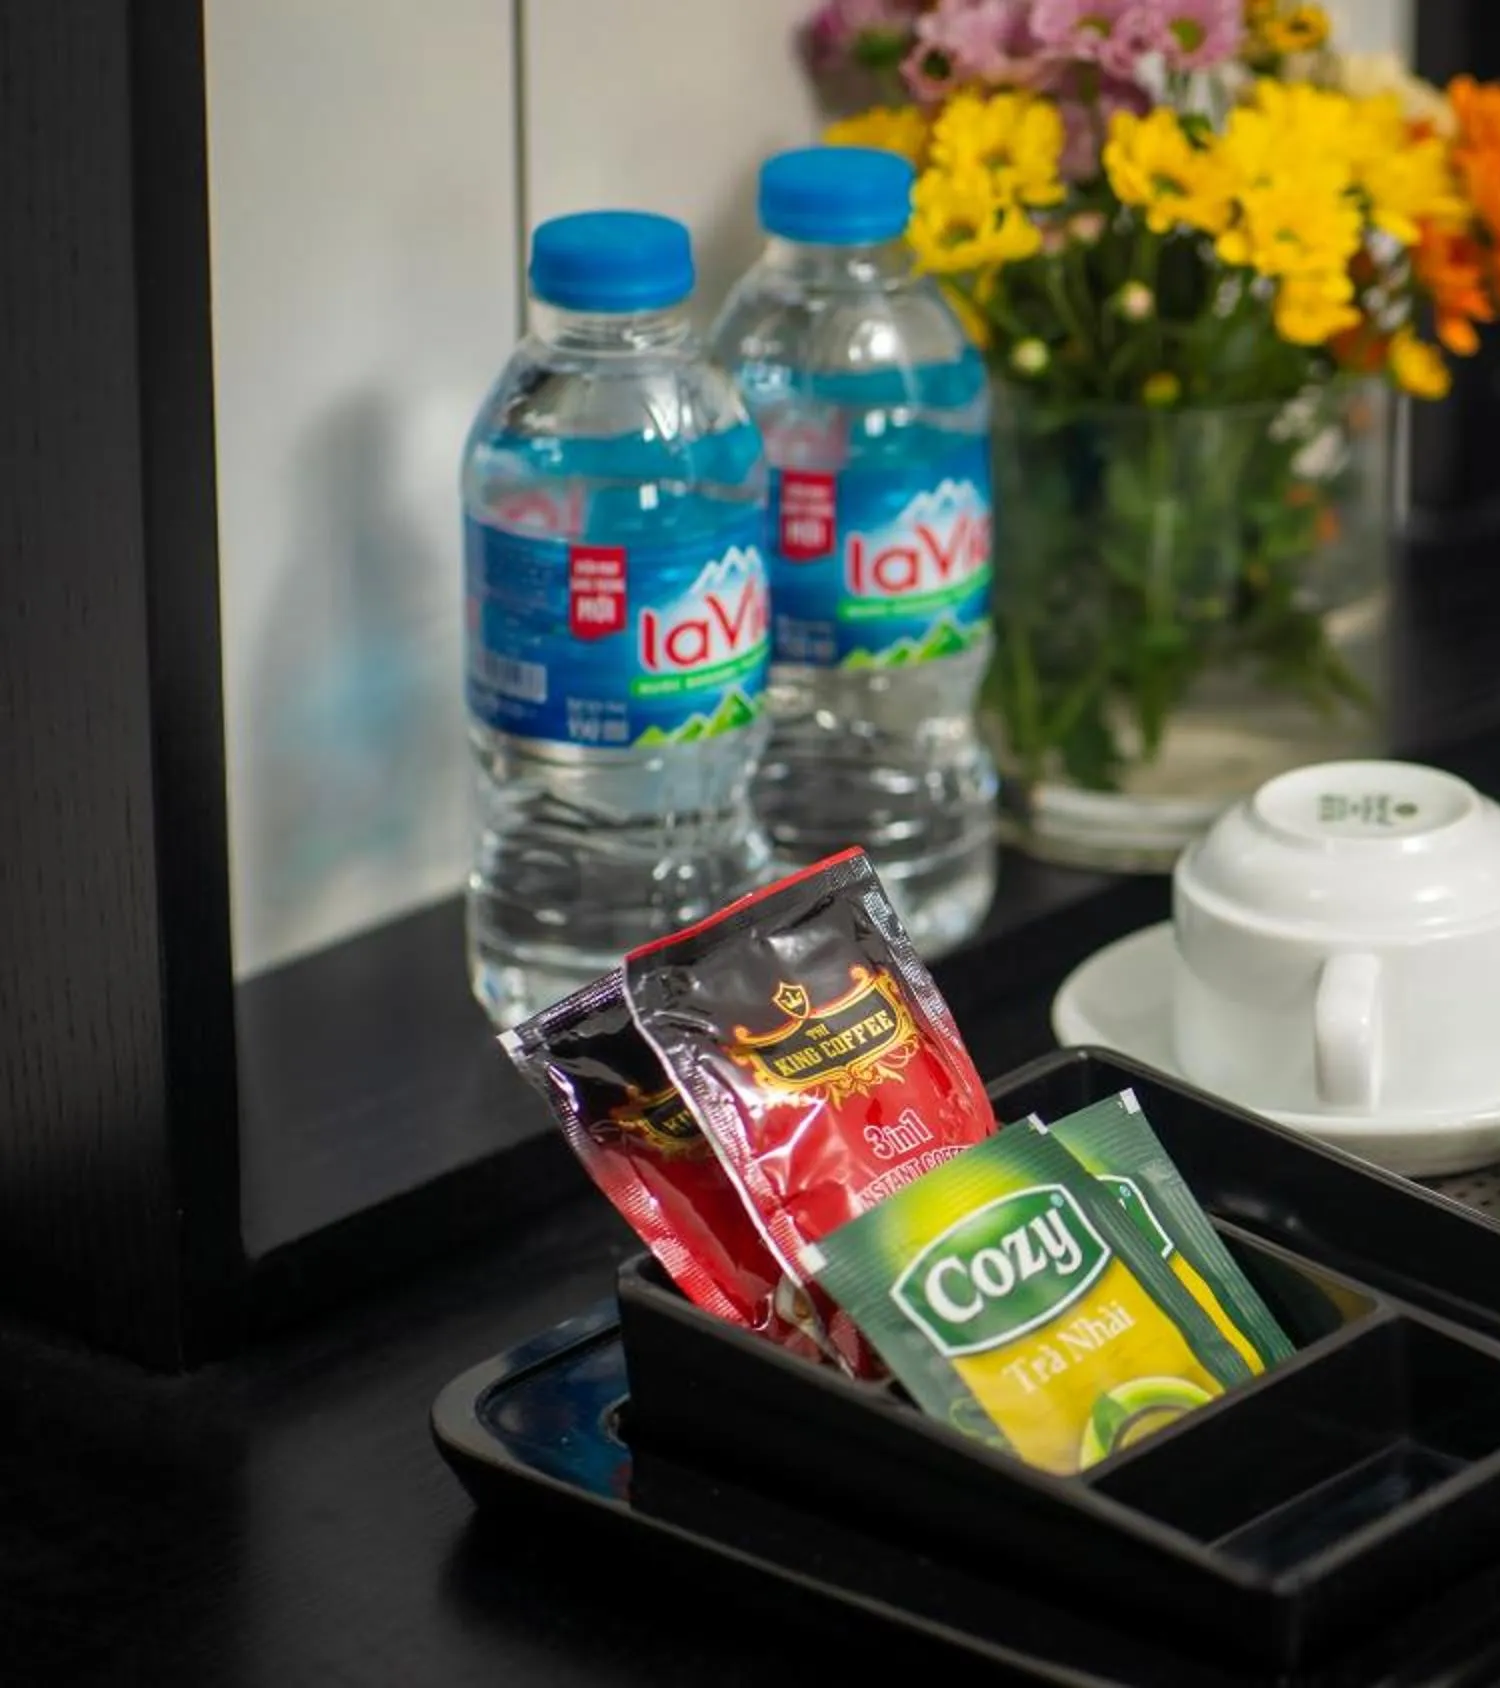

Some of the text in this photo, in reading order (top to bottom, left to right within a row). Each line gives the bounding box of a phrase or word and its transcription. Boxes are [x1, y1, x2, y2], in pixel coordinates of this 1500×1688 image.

[773, 1009, 895, 1077] KING COFFEE
[863, 1107, 934, 1160] 3in1
[859, 1156, 921, 1211] NSTANT
[924, 1207, 1083, 1325] Cozy
[1001, 1299, 1136, 1394] Trà Nhài
